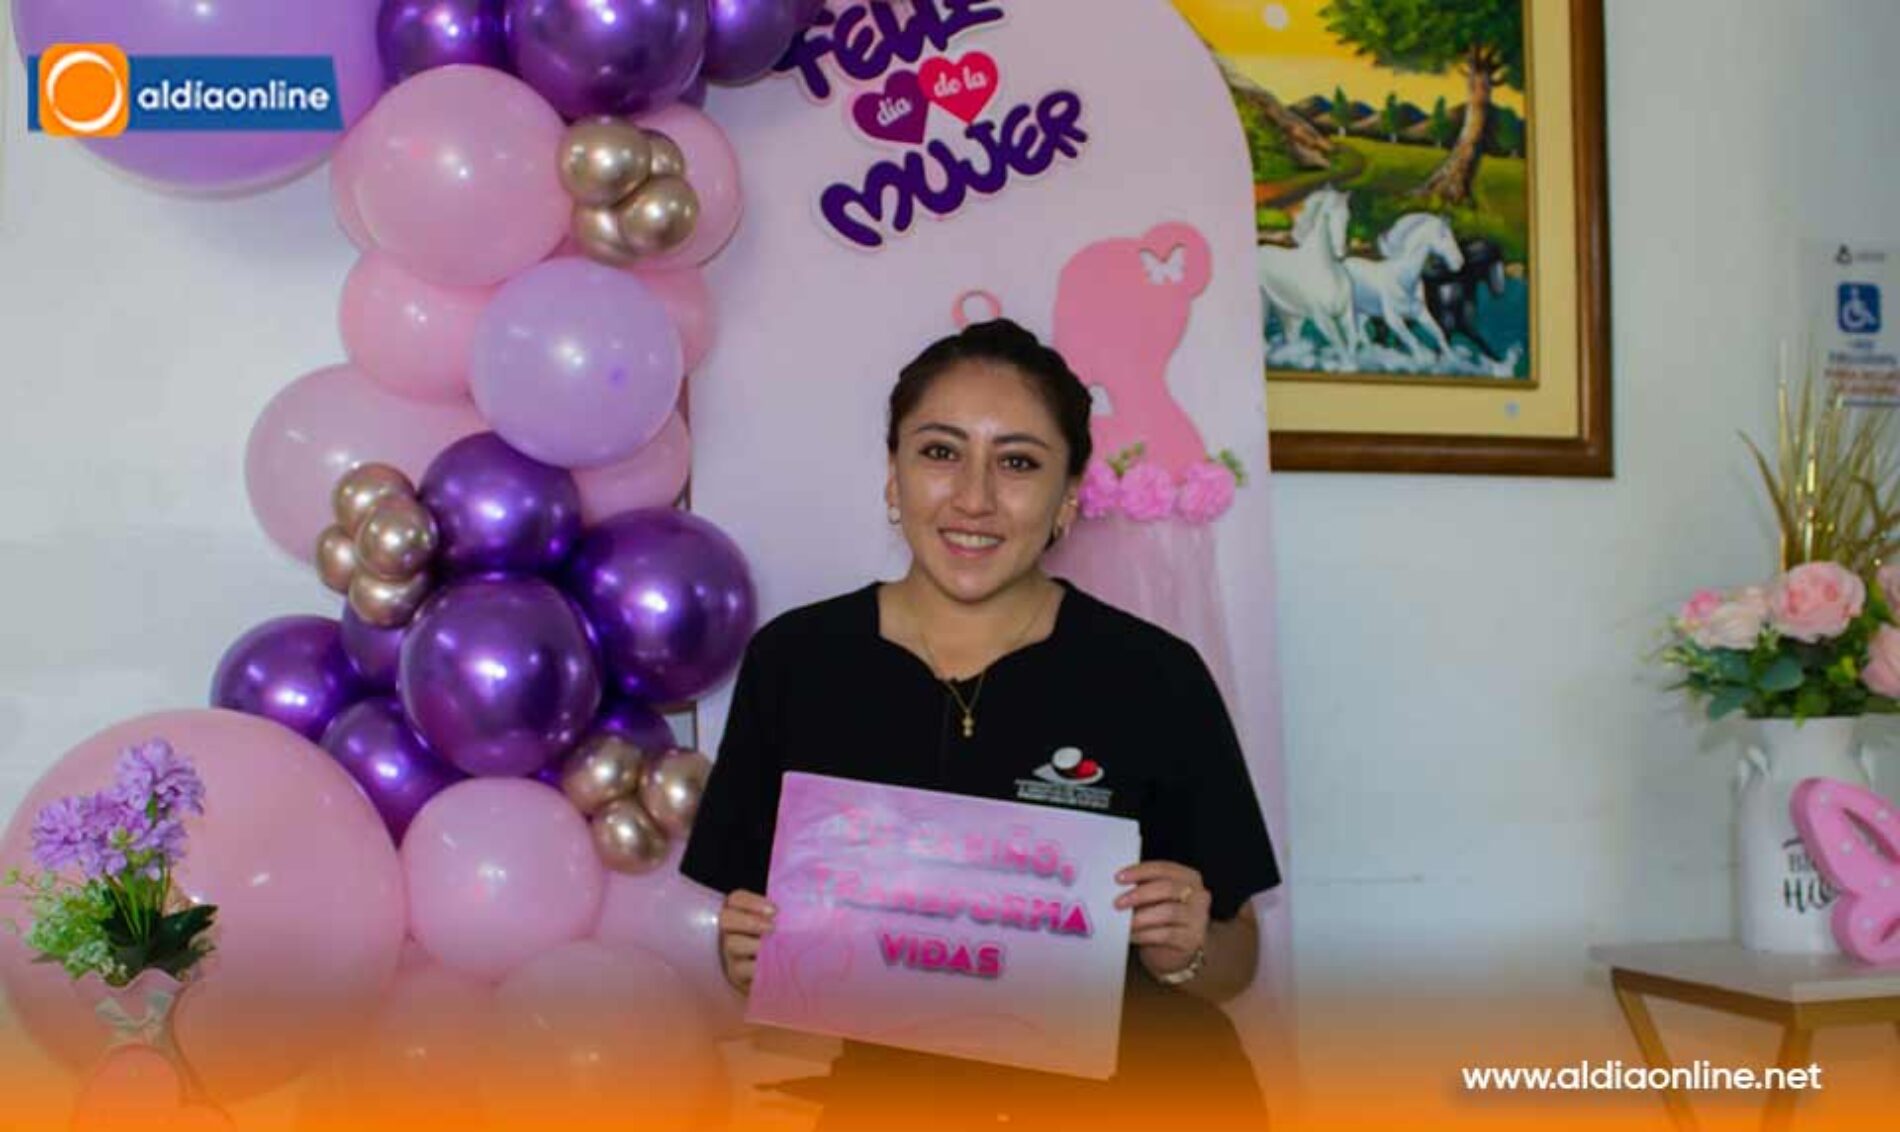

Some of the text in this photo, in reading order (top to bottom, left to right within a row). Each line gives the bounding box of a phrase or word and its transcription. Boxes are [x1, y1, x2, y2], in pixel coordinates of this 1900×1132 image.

[963, 65, 988, 91] la
[820, 90, 1087, 247] MUJER
[814, 863, 1092, 937] TRANSFORMA
[880, 931, 1006, 979] VIDAS
